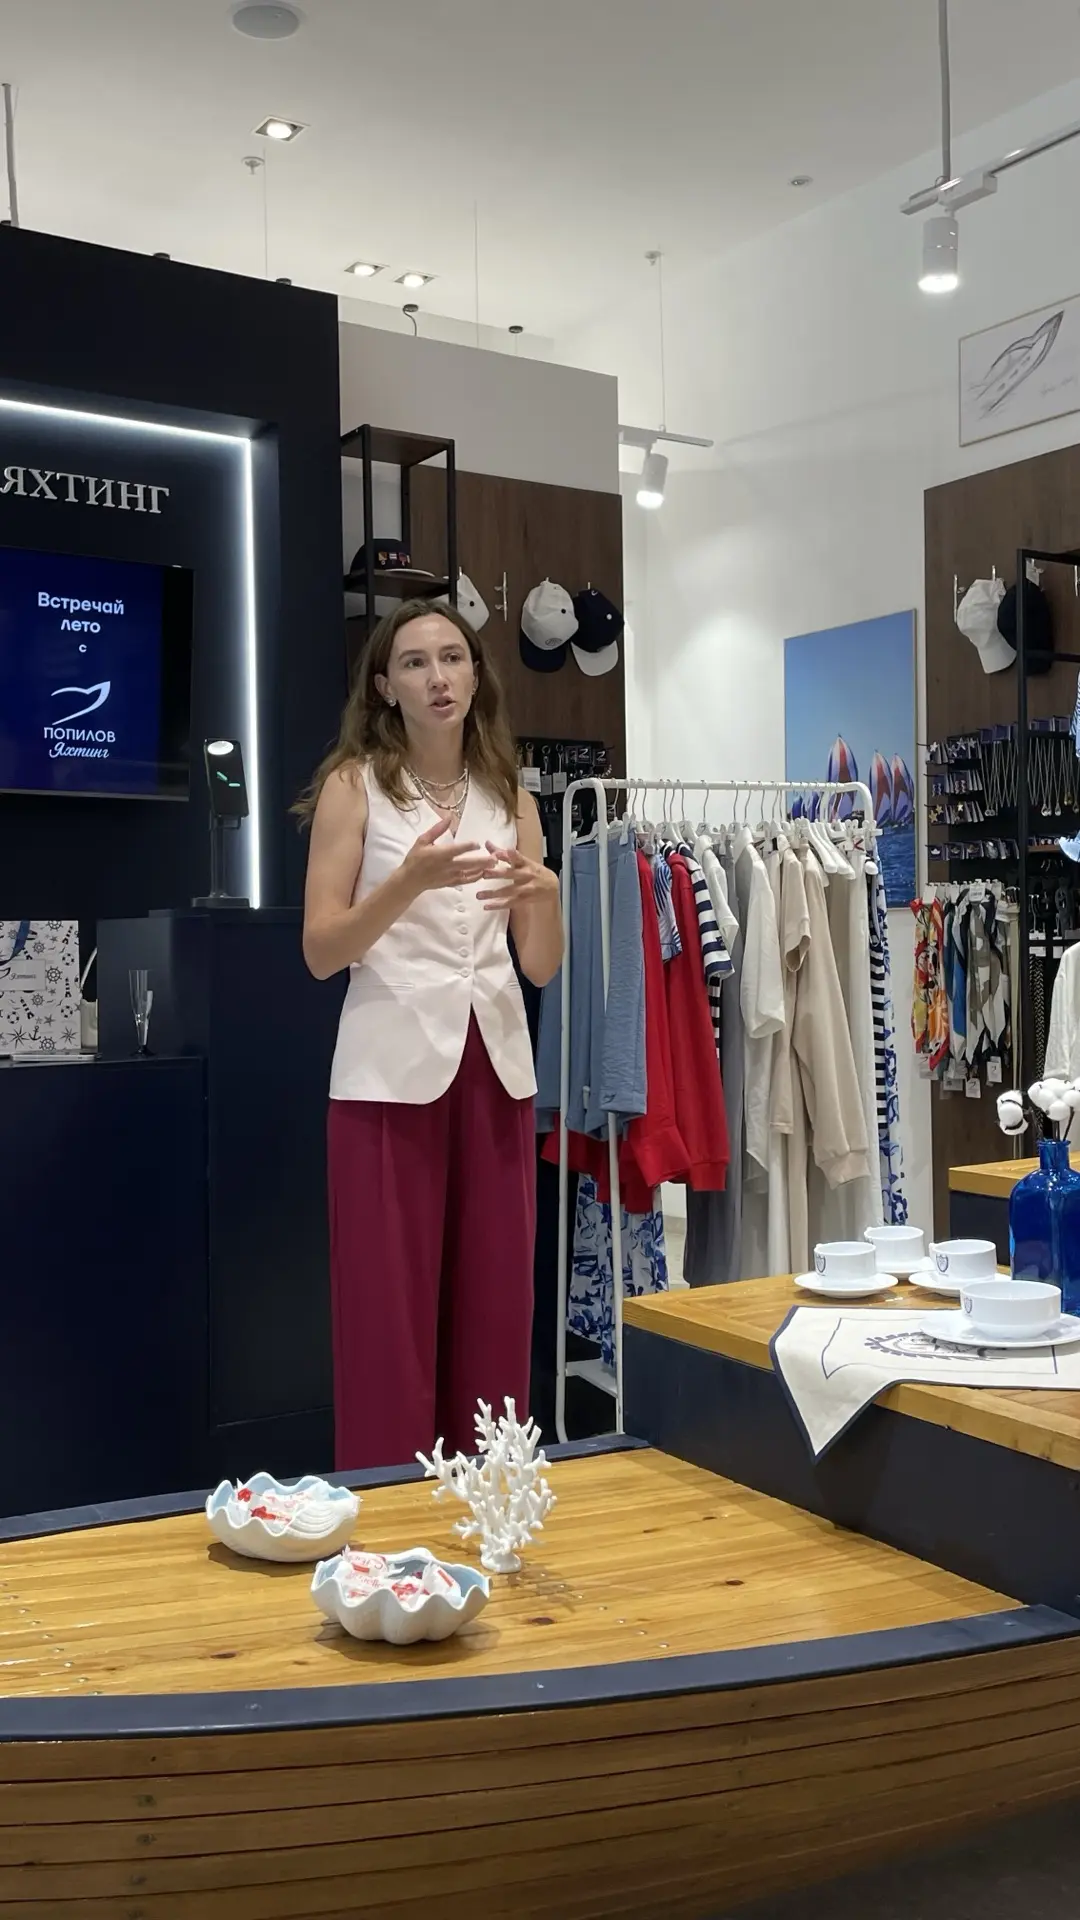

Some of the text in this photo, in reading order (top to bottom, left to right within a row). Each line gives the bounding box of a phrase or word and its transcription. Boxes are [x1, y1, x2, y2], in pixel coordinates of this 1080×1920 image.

[0, 466, 169, 513] ЯХТИНГ
[38, 591, 124, 615] Встречай
[60, 618, 101, 633] лето
[79, 644, 87, 653] с
[43, 726, 116, 743] ПОПИЛОВ
[49, 741, 109, 758] Яхтинг
